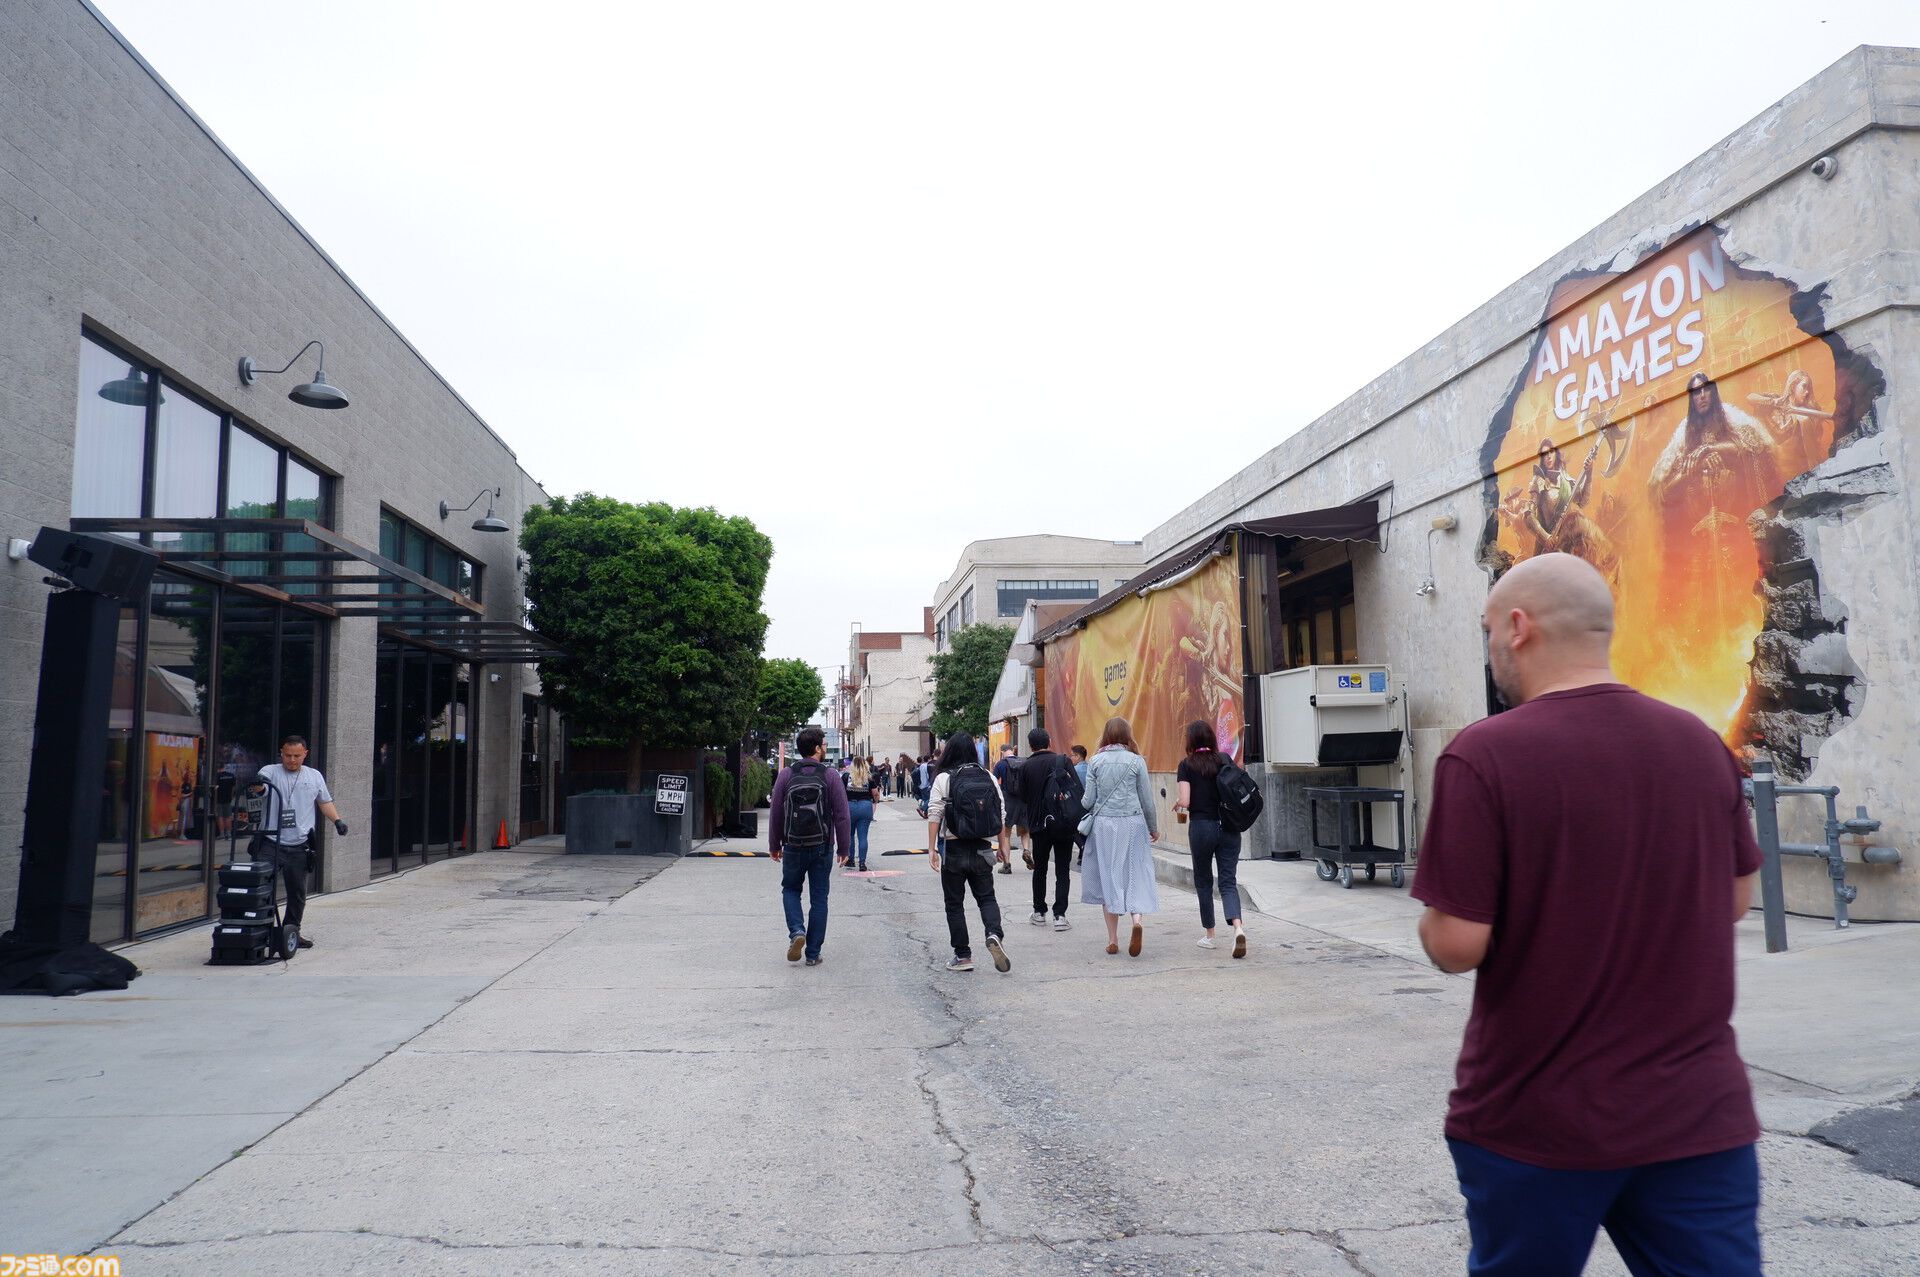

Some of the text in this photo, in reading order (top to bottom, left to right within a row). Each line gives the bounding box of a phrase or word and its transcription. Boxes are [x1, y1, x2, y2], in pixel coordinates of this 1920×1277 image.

[1534, 239, 1725, 384] AMAZON
[1554, 310, 1704, 419] GAMES
[1104, 661, 1127, 689] games
[660, 791, 682, 801] 5 MPH
